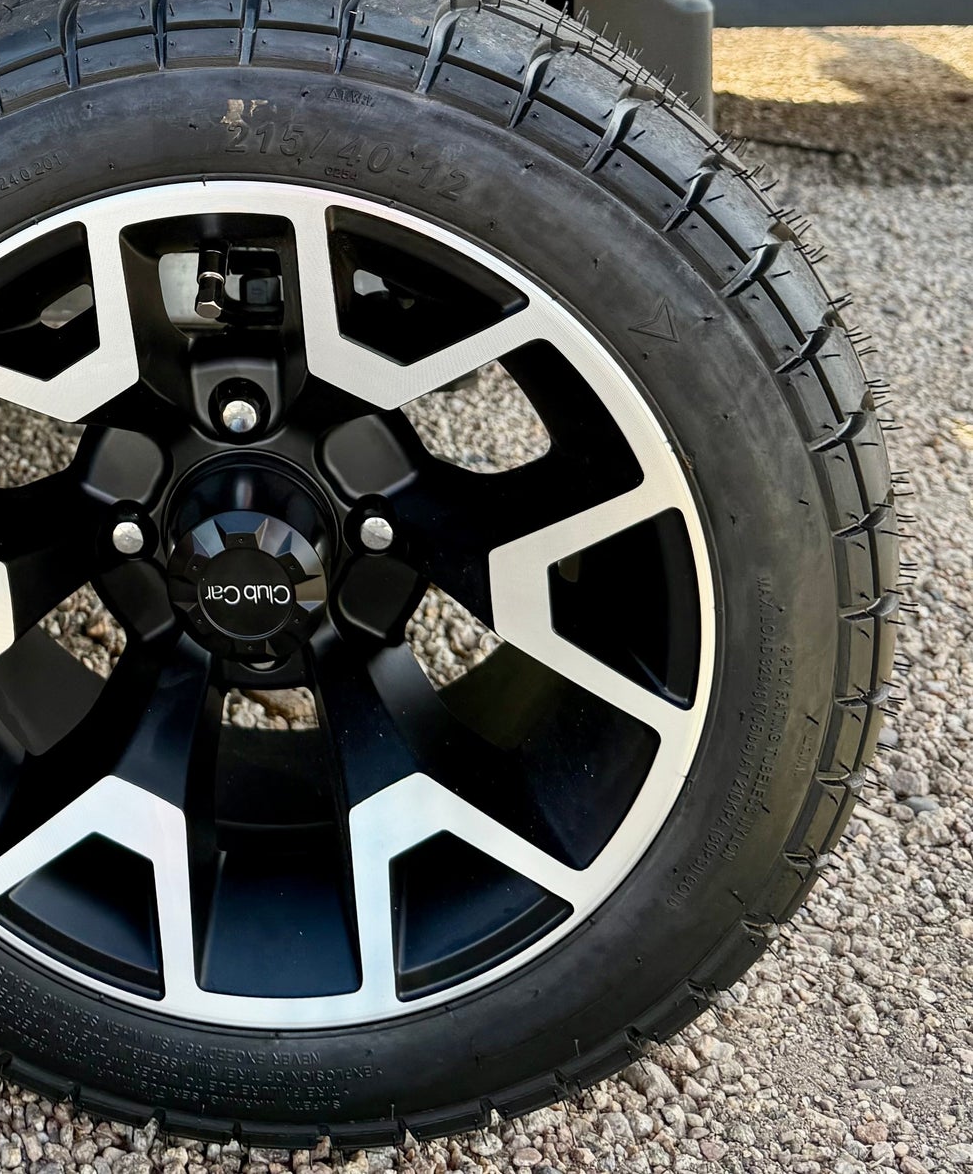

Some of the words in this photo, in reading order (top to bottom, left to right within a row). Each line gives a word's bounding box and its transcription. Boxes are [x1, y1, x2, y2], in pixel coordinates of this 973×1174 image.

[205, 584, 241, 605] Car
[243, 584, 291, 605] Club
[272, 1050, 320, 1065] NEVER
